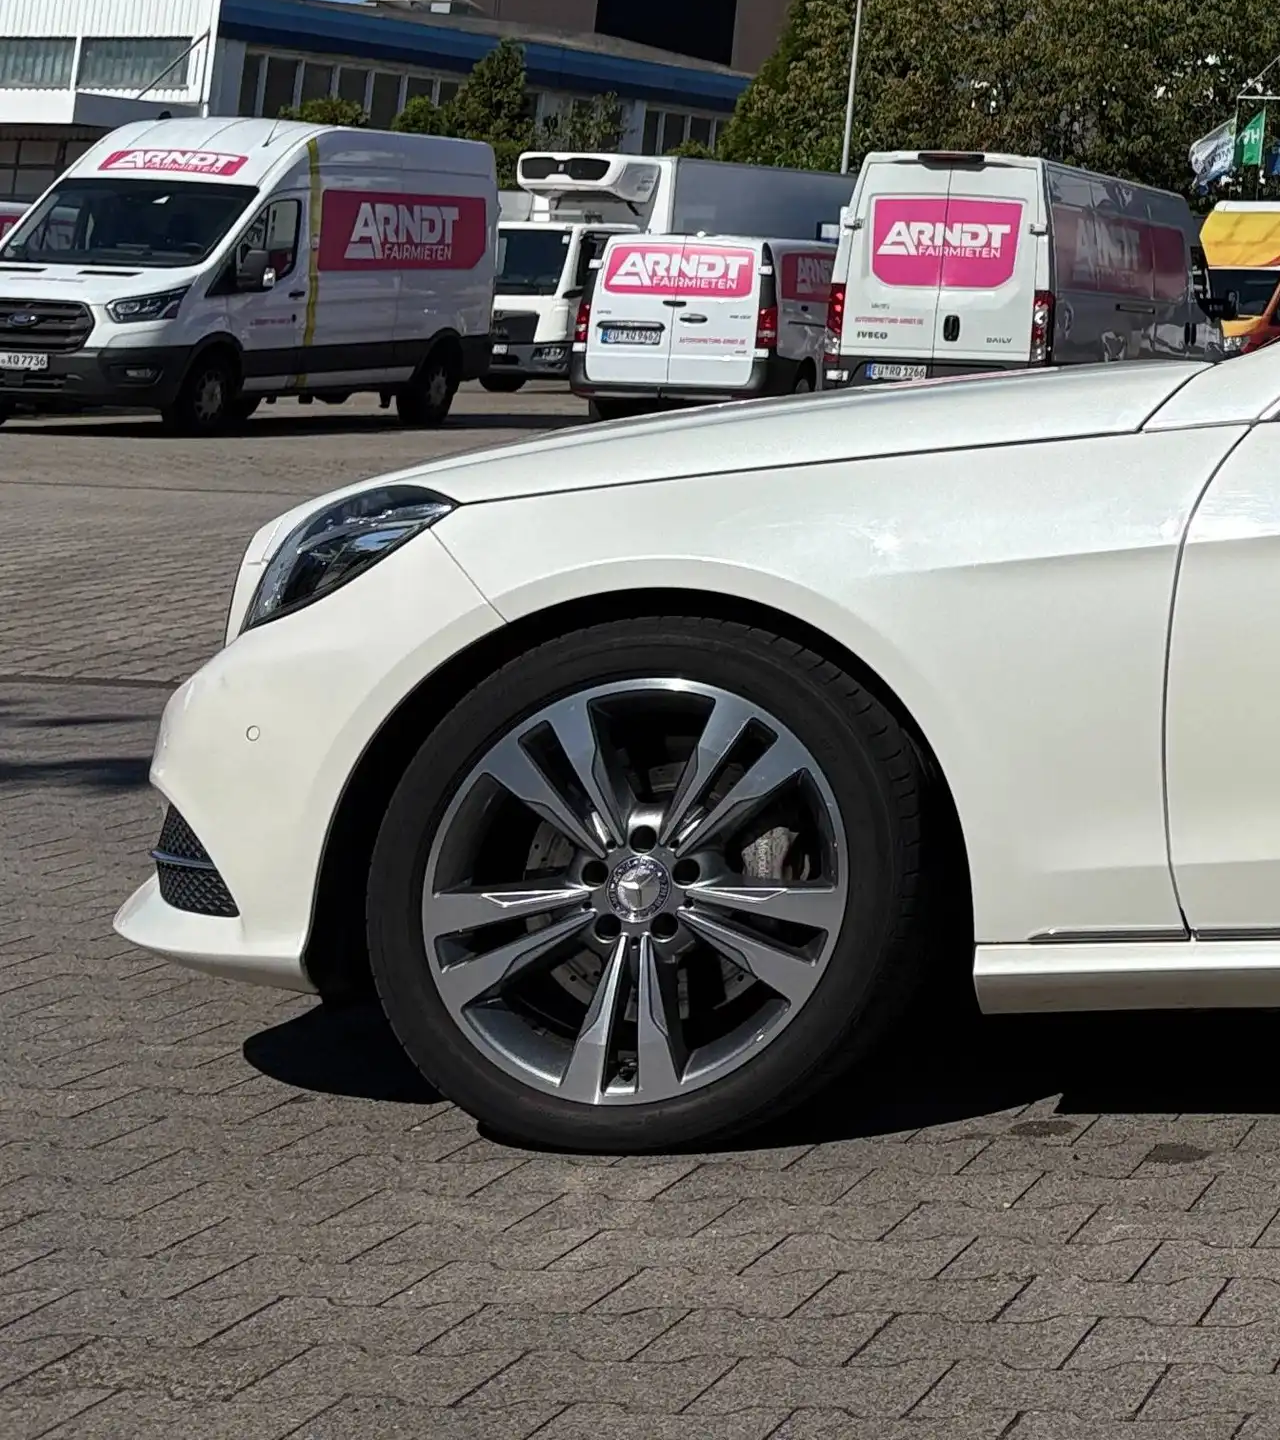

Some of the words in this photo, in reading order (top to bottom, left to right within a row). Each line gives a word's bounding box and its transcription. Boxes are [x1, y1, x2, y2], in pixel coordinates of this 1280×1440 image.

[107, 150, 239, 169] ARNDT
[343, 202, 459, 260] ARNDT
[876, 221, 1011, 256] ARNDT
[383, 244, 452, 260] FAIRMIETEN
[918, 246, 1001, 258] FAIRMIETEN
[608, 252, 750, 286] ARNDT
[652, 276, 737, 290] FAIRMIETEN
[857, 331, 888, 340] IVECO
